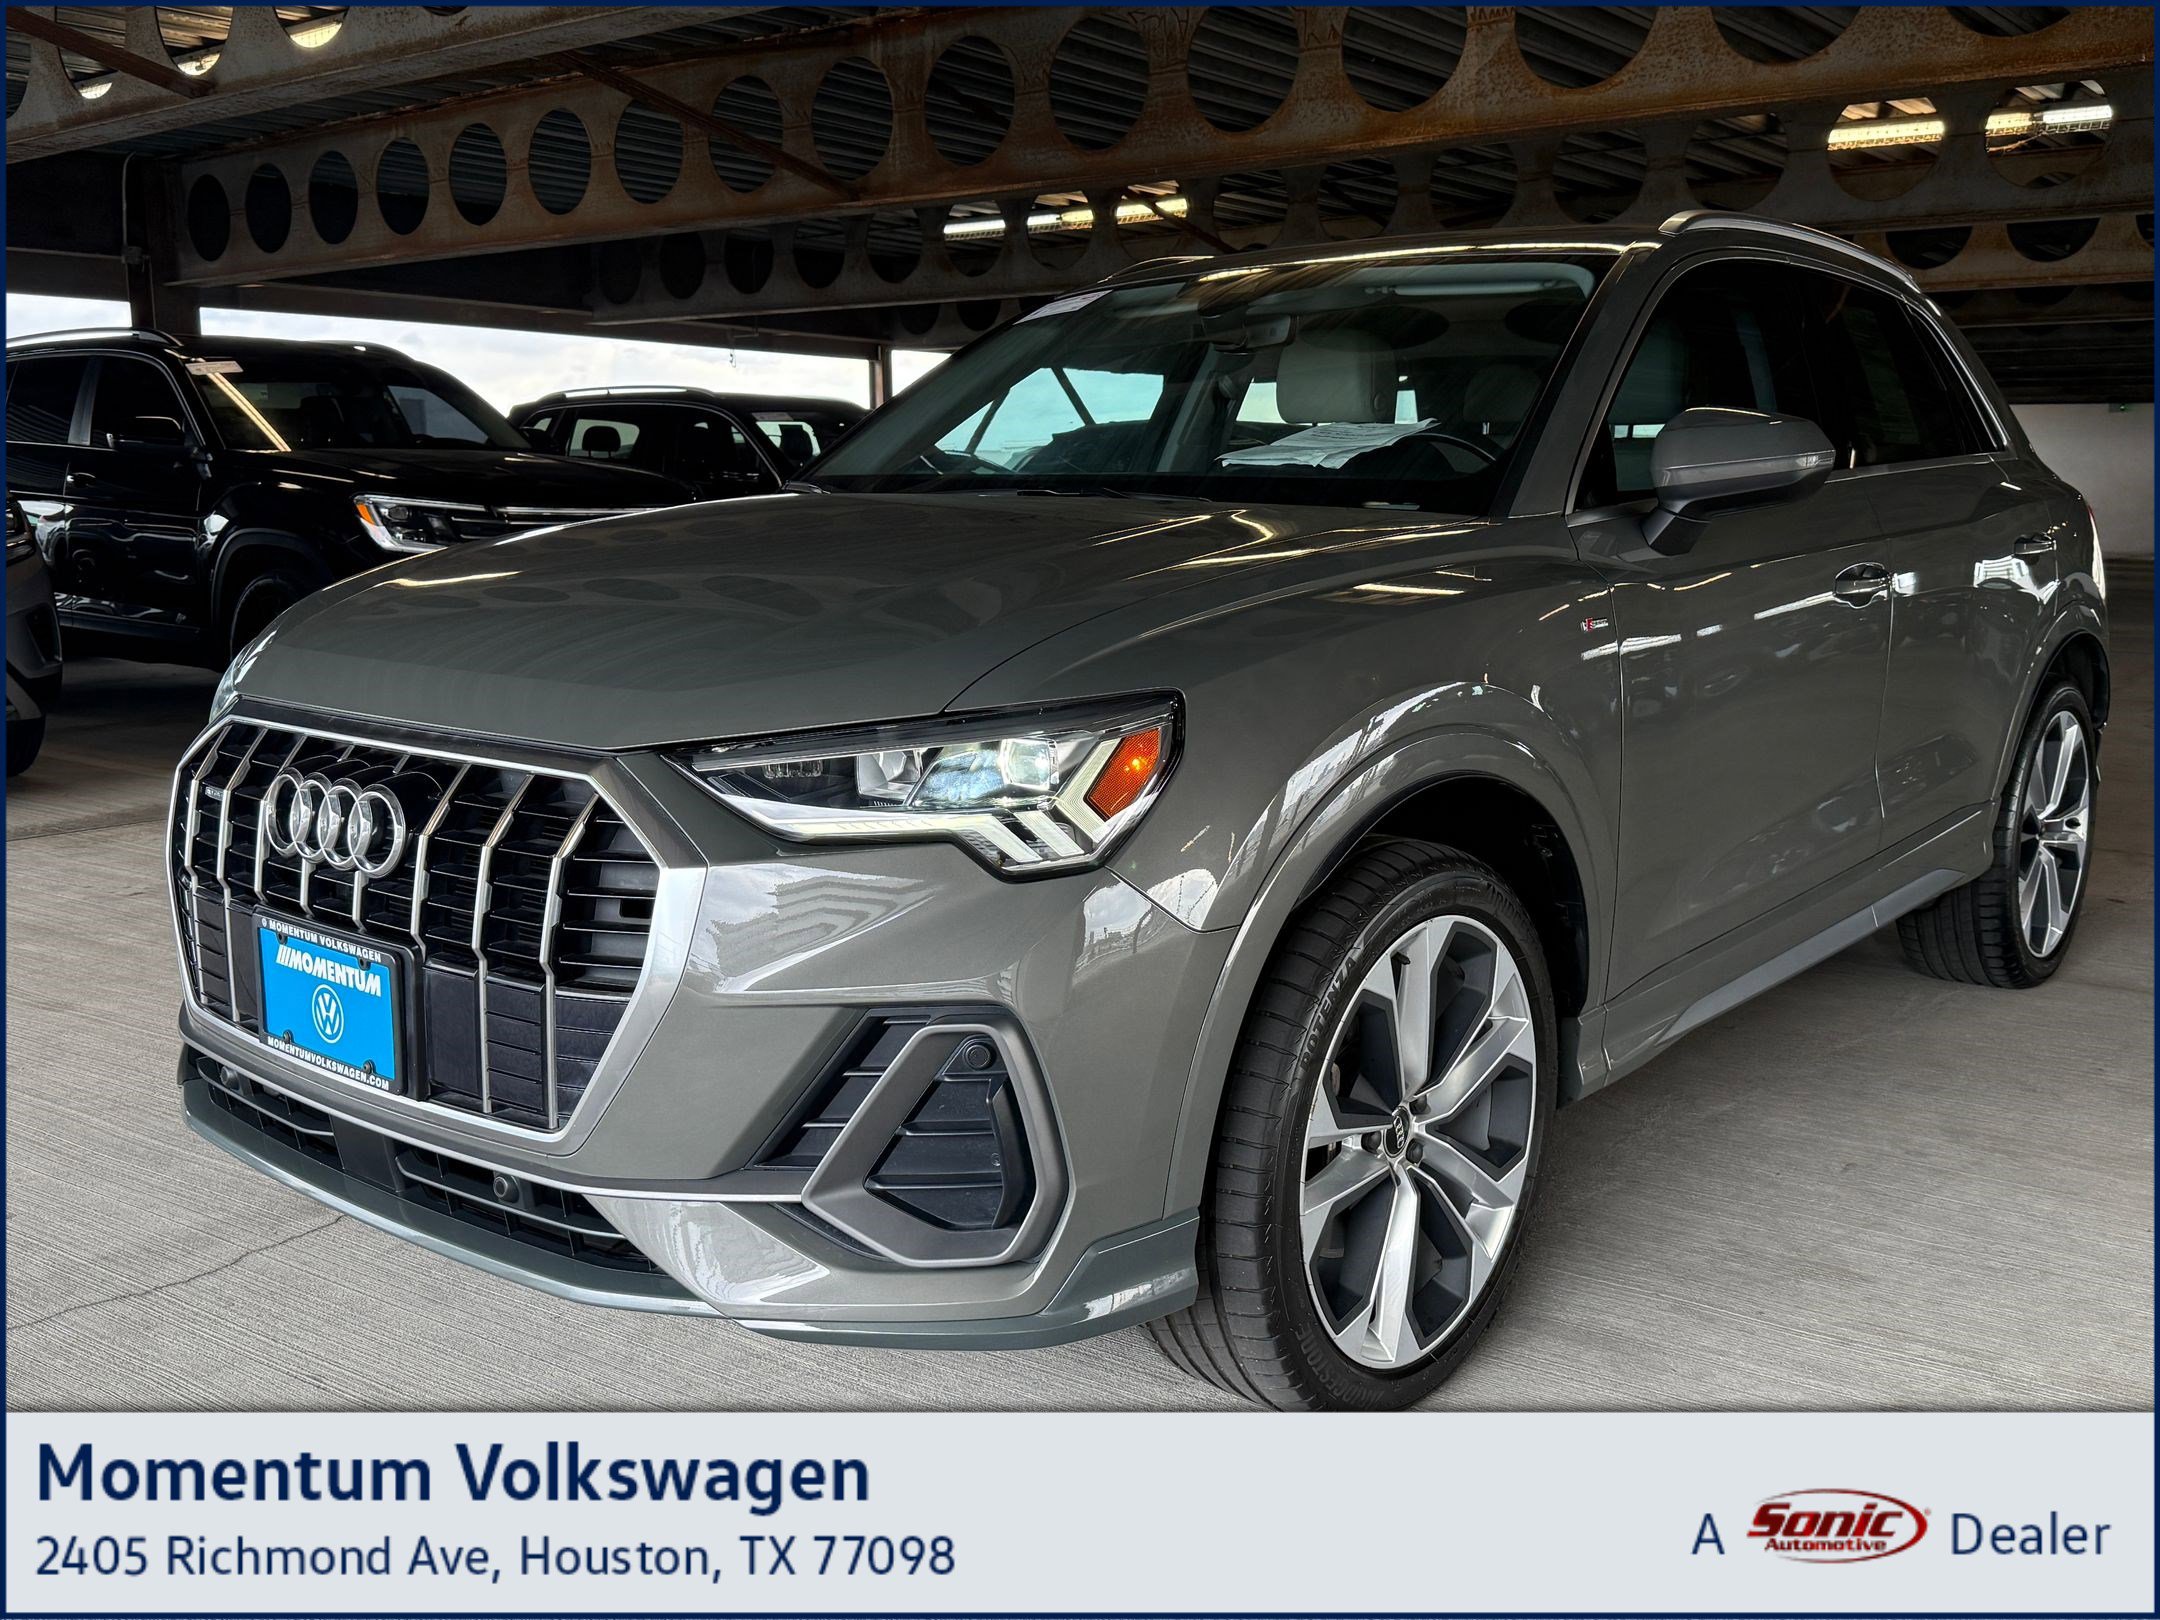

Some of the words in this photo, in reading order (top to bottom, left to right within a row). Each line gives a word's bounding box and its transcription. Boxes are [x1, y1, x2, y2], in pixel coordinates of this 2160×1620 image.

[269, 919, 317, 943] MOMENTUM
[320, 935, 382, 963] VOLKSWAGEN
[1299, 956, 1357, 1073] POTENZA
[267, 1035, 390, 1091] MOMENTUMVOLKSWAGEN.COM
